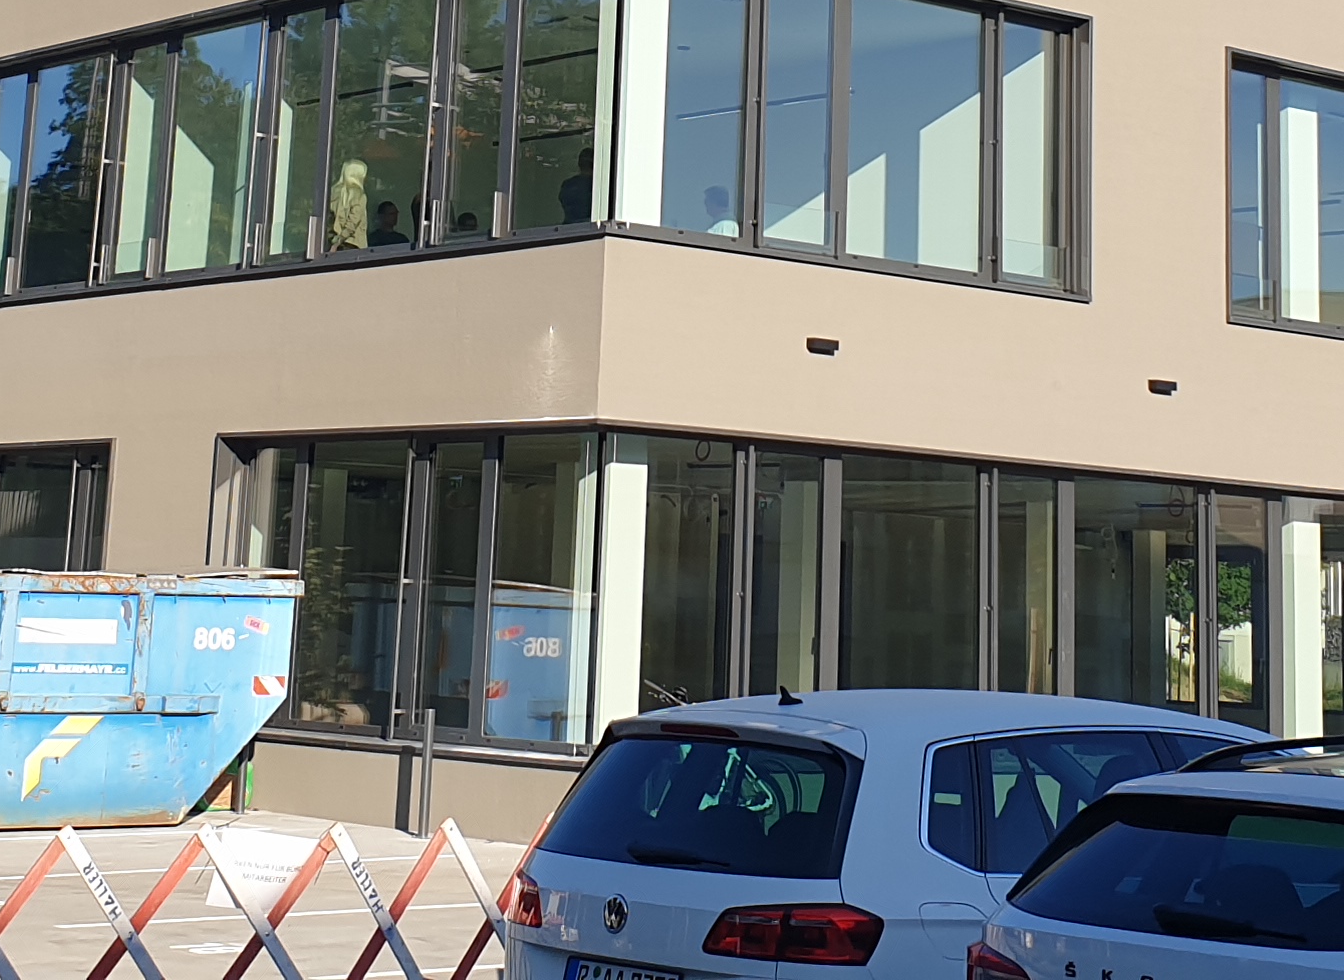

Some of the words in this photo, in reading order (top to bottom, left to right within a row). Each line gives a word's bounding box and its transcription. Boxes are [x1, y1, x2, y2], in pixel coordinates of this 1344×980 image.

[193, 626, 236, 651] 806
[83, 861, 122, 921] HALLER
[351, 856, 385, 914] HALLER
